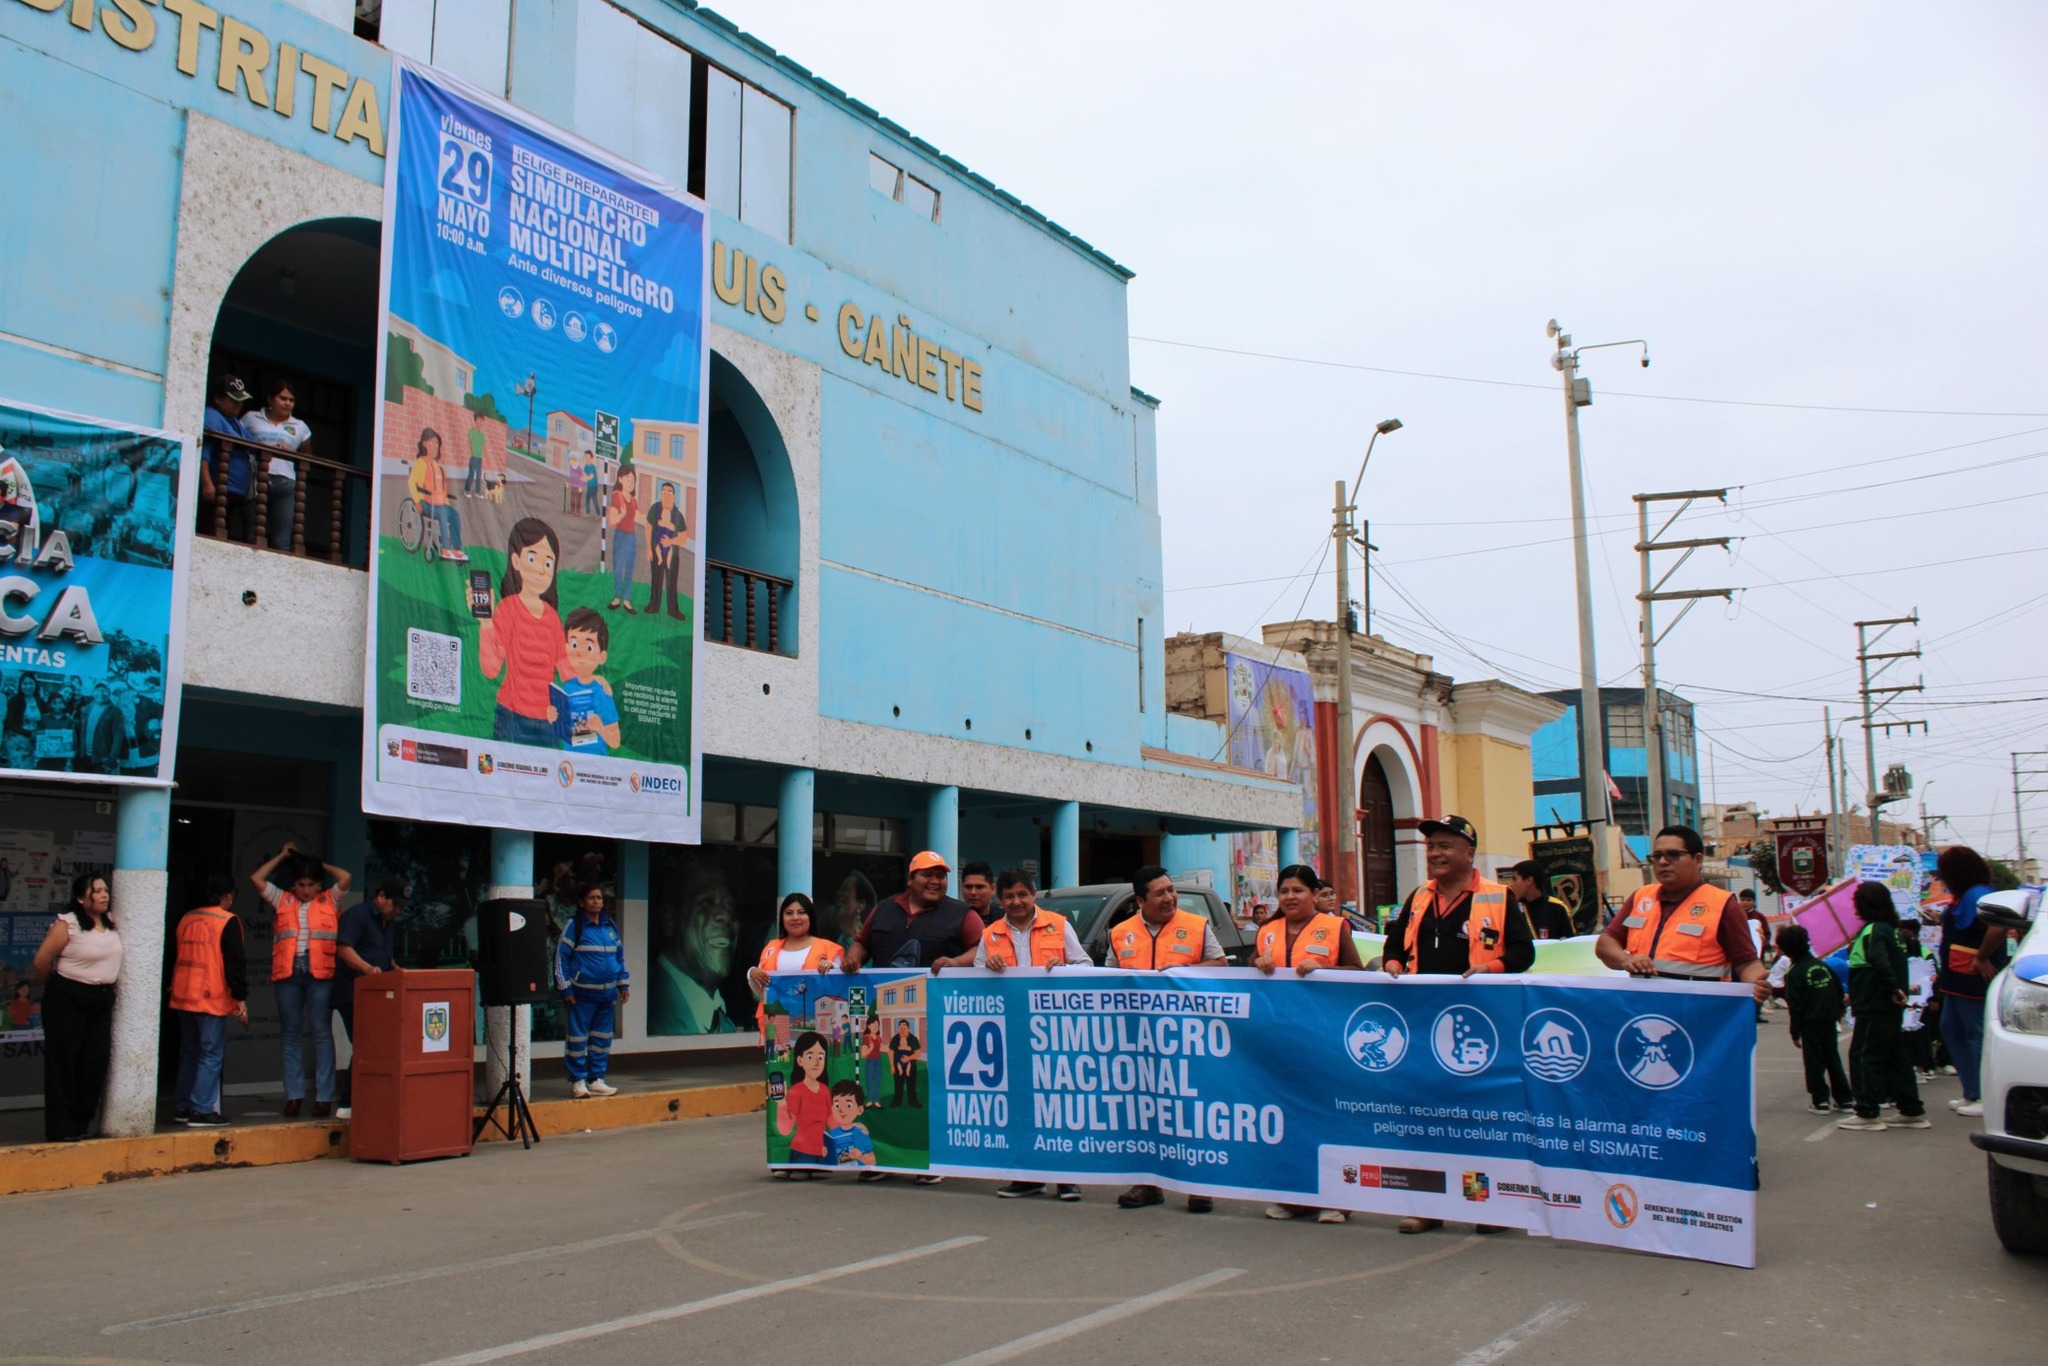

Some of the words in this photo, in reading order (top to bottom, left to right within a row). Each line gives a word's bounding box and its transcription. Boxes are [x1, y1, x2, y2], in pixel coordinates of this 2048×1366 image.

[440, 114, 492, 151] viernes
[441, 139, 491, 206] 29
[516, 148, 562, 181] ¡ELIGE
[565, 171, 655, 224] PREPARARTE!
[437, 194, 490, 238] MAYO
[511, 165, 646, 248] SIMULACRO
[437, 222, 465, 247] 10:00
[466, 239, 487, 256] a.m.
[510, 191, 627, 267] NACIONAL
[508, 252, 538, 276] Ante
[541, 266, 593, 298] diversos
[595, 289, 643, 318] peligros
[509, 222, 674, 314] MULTIPELIGRO
[712, 240, 787, 323] UIS
[838, 301, 983, 413] CAÑETE
[474, 593, 489, 604] 119
[0, 645, 66, 668] NTAS
[641, 775, 681, 791] INDECI
[944, 990, 1005, 1014] viernes
[1034, 993, 1094, 1010] ¡ELIGE
[1101, 993, 1240, 1014] PREPARARTE!
[947, 1020, 1004, 1088] 29
[1029, 1014, 1232, 1058] SIMULACRO
[1032, 1054, 1199, 1098] NACIONAL
[947, 1093, 1008, 1128] MAYO
[1033, 1093, 1286, 1146] MULTIPELIGRO
[1335, 1097, 1406, 1115] Importante:
[1410, 1104, 1469, 1120] recuerda
[1472, 1110, 1499, 1124] que
[1559, 1114, 1572, 1129] la
[1575, 1117, 1626, 1134] alarma
[1631, 1124, 1662, 1138] ante
[1667, 1127, 1707, 1143] estos
[947, 1128, 980, 1147] 10:00
[984, 1133, 1009, 1149] a.m.
[1034, 1134, 1074, 1153] Ante
[1079, 1137, 1156, 1155] diversos
[1159, 1143, 1229, 1167] peligros
[1374, 1121, 1425, 1137] peligros
[1428, 1126, 1444, 1137] en
[1448, 1127, 1461, 1138] tu
[1464, 1127, 1509, 1142] celular
[1573, 1138, 1585, 1152] el
[1589, 1139, 1663, 1161] SISMATE.
[1361, 1171, 1380, 1181] PERÚ
[1497, 1182, 1530, 1194] GOBIERNO
[1552, 1193, 1562, 1203] DE
[1563, 1194, 1582, 1205] LIMA
[1644, 1203, 1674, 1214] GERENCIA
[1676, 1207, 1706, 1219] REGIONAL
[1707, 1212, 1715, 1220] DE
[1652, 1213, 1664, 1222] DEL
[1666, 1215, 1688, 1225] RIESGO
[1690, 1218, 1698, 1227] DE
[1700, 1220, 1734, 1233] DESASTRES
